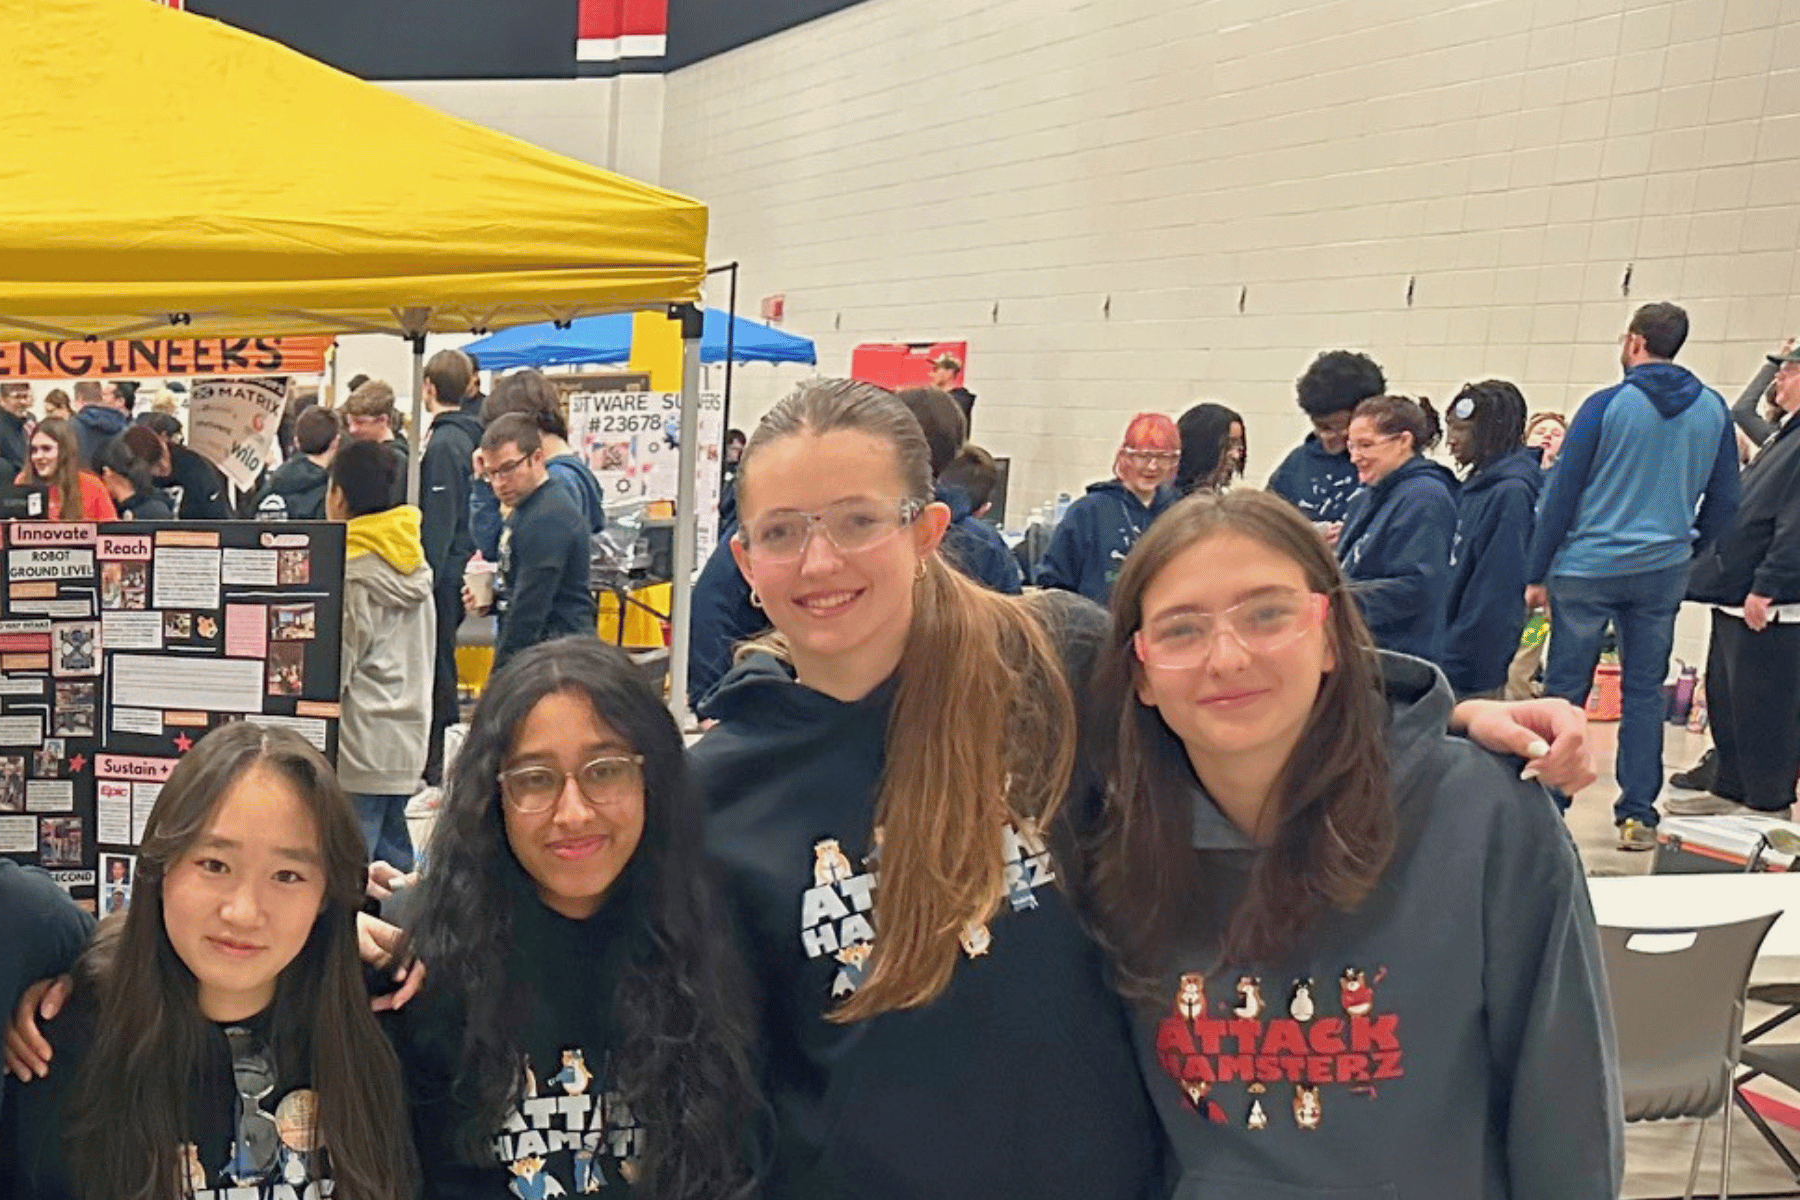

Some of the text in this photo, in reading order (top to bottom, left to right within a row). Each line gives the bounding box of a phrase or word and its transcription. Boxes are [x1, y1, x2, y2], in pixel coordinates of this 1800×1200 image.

[218, 387, 281, 416] MATRIX
[588, 414, 662, 433] #23678
[231, 441, 260, 471] wilo
[17, 525, 89, 541] Innovate
[31, 551, 71, 561] ROBOT
[103, 540, 148, 555] Reach
[10, 563, 94, 578] GROUND LEVEL
[103, 759, 157, 776] Sustain
[1157, 1014, 1400, 1054] ATTACK
